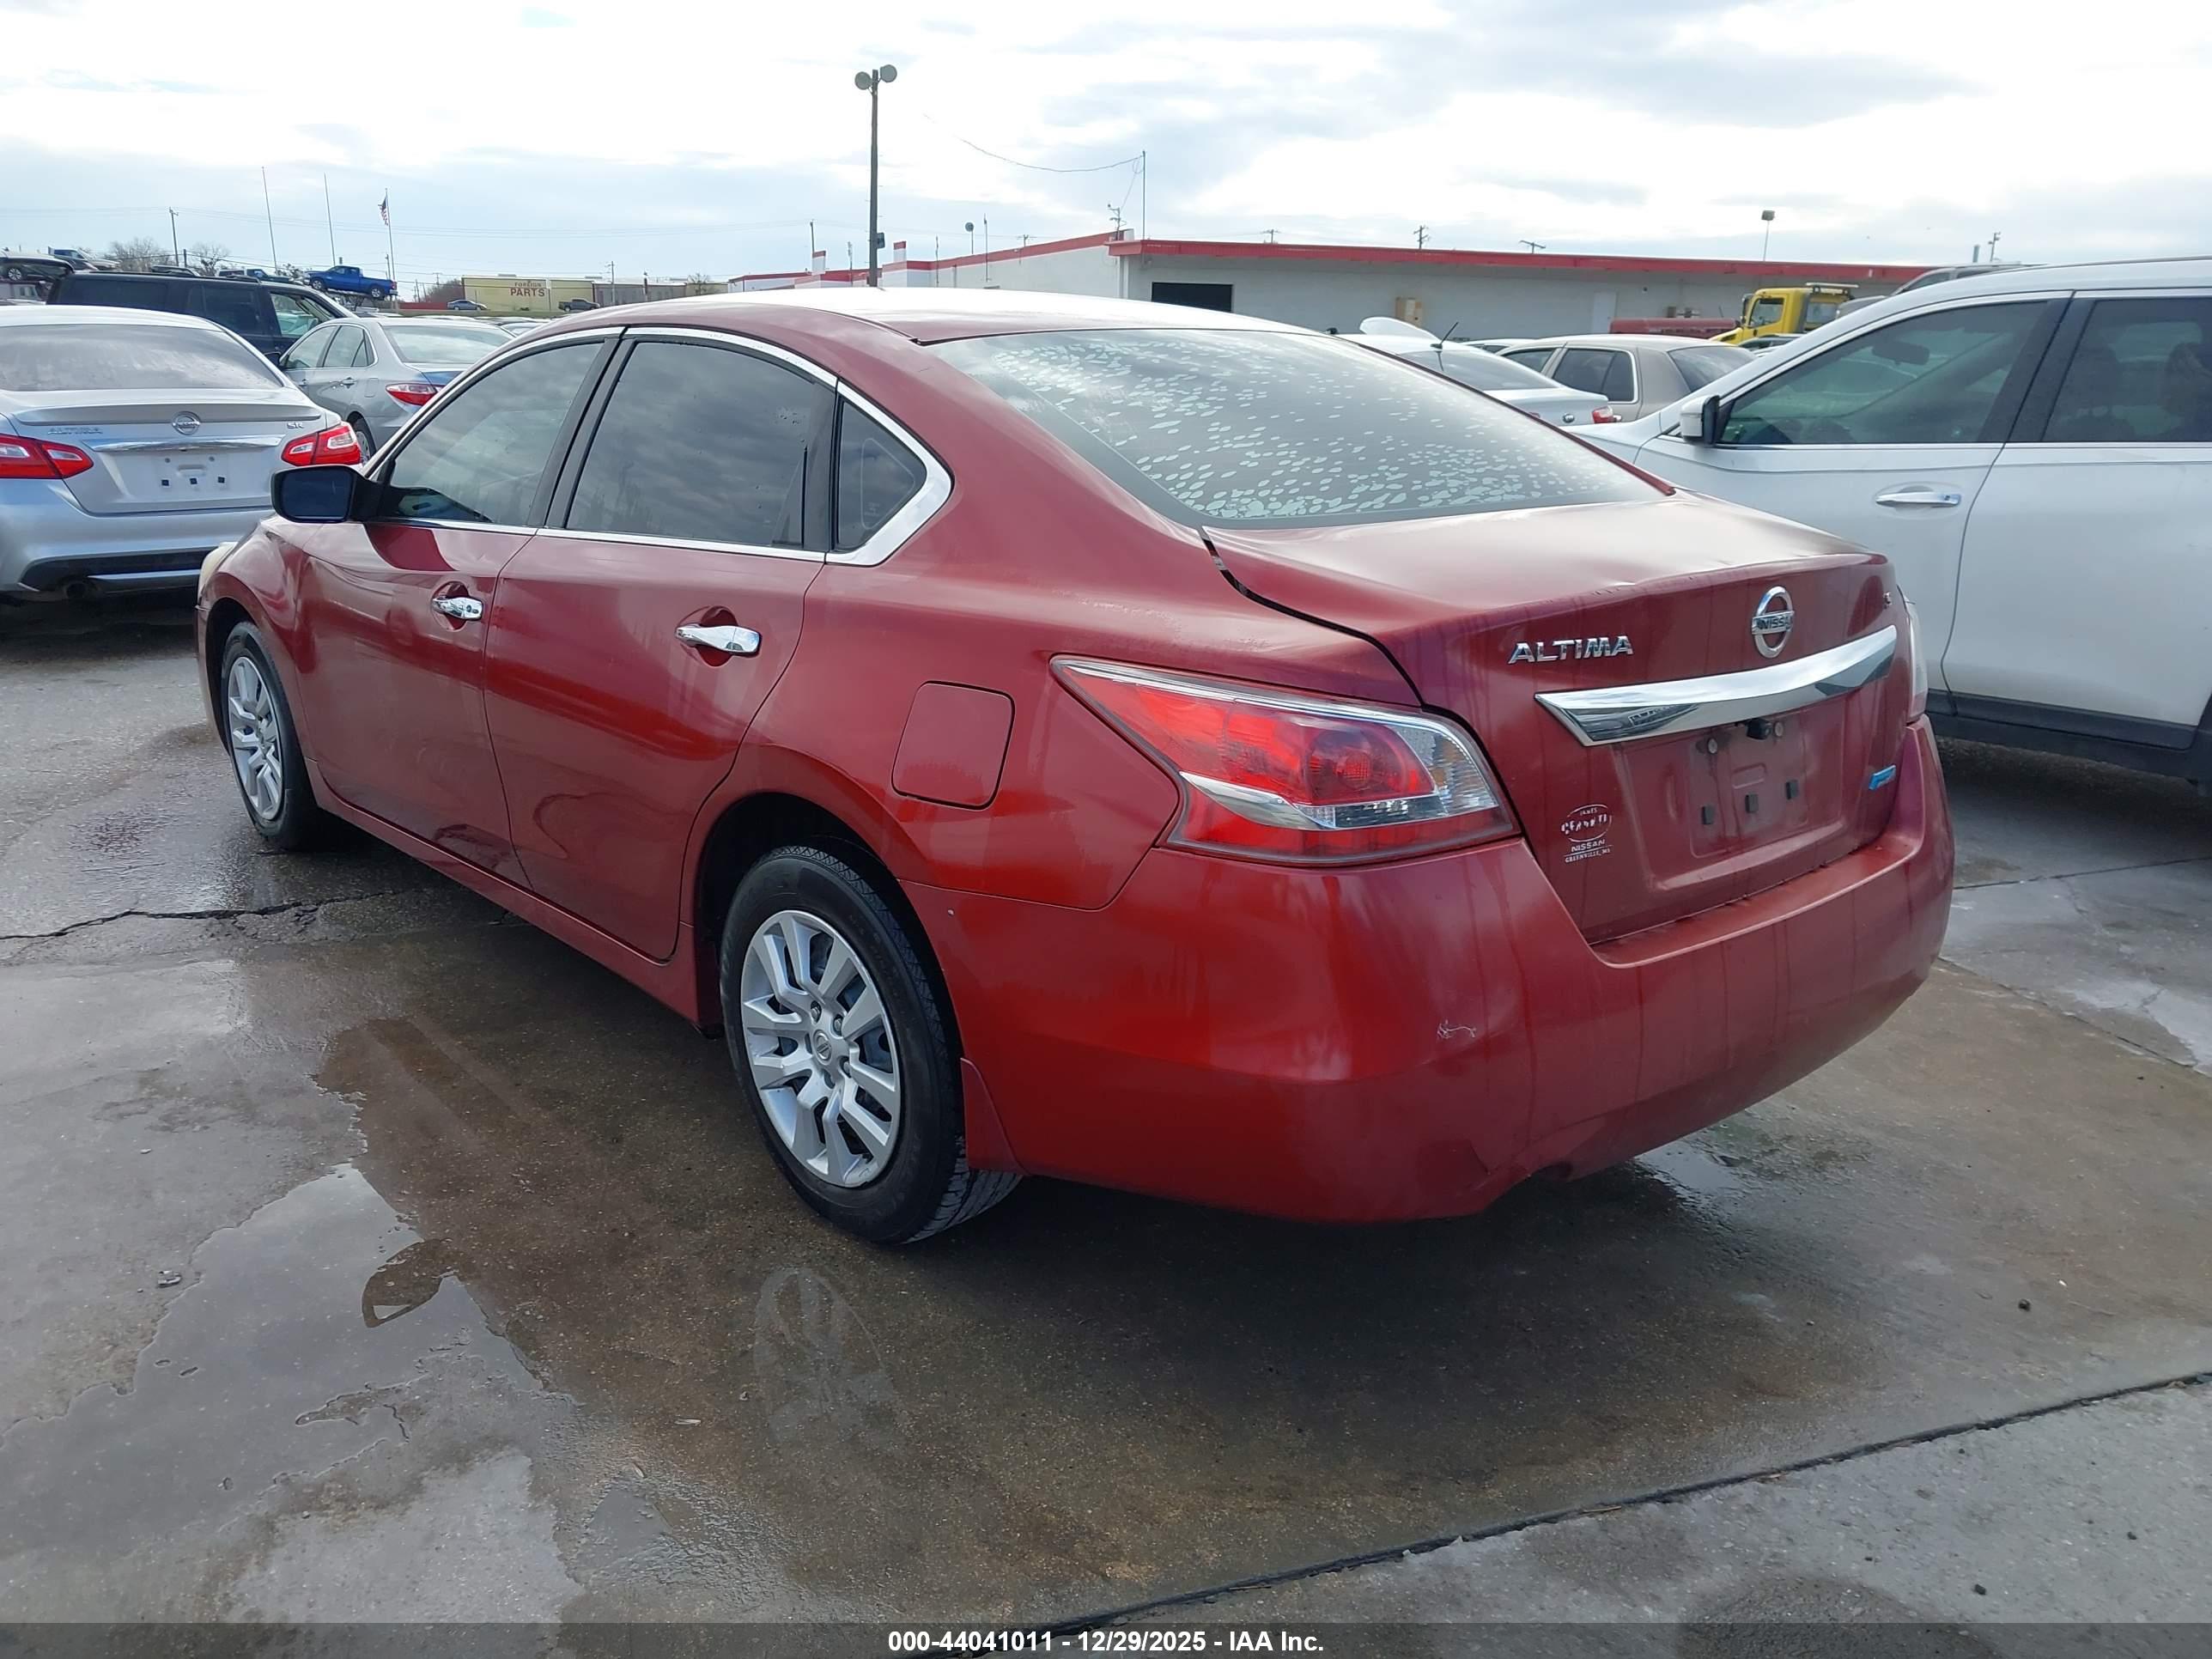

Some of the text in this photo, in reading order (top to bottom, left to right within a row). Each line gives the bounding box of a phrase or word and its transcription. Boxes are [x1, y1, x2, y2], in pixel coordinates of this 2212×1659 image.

[510, 288, 545, 297] PARTS
[1508, 635, 1633, 665] ALTIMA
[1571, 839, 1605, 853] NISSAN
